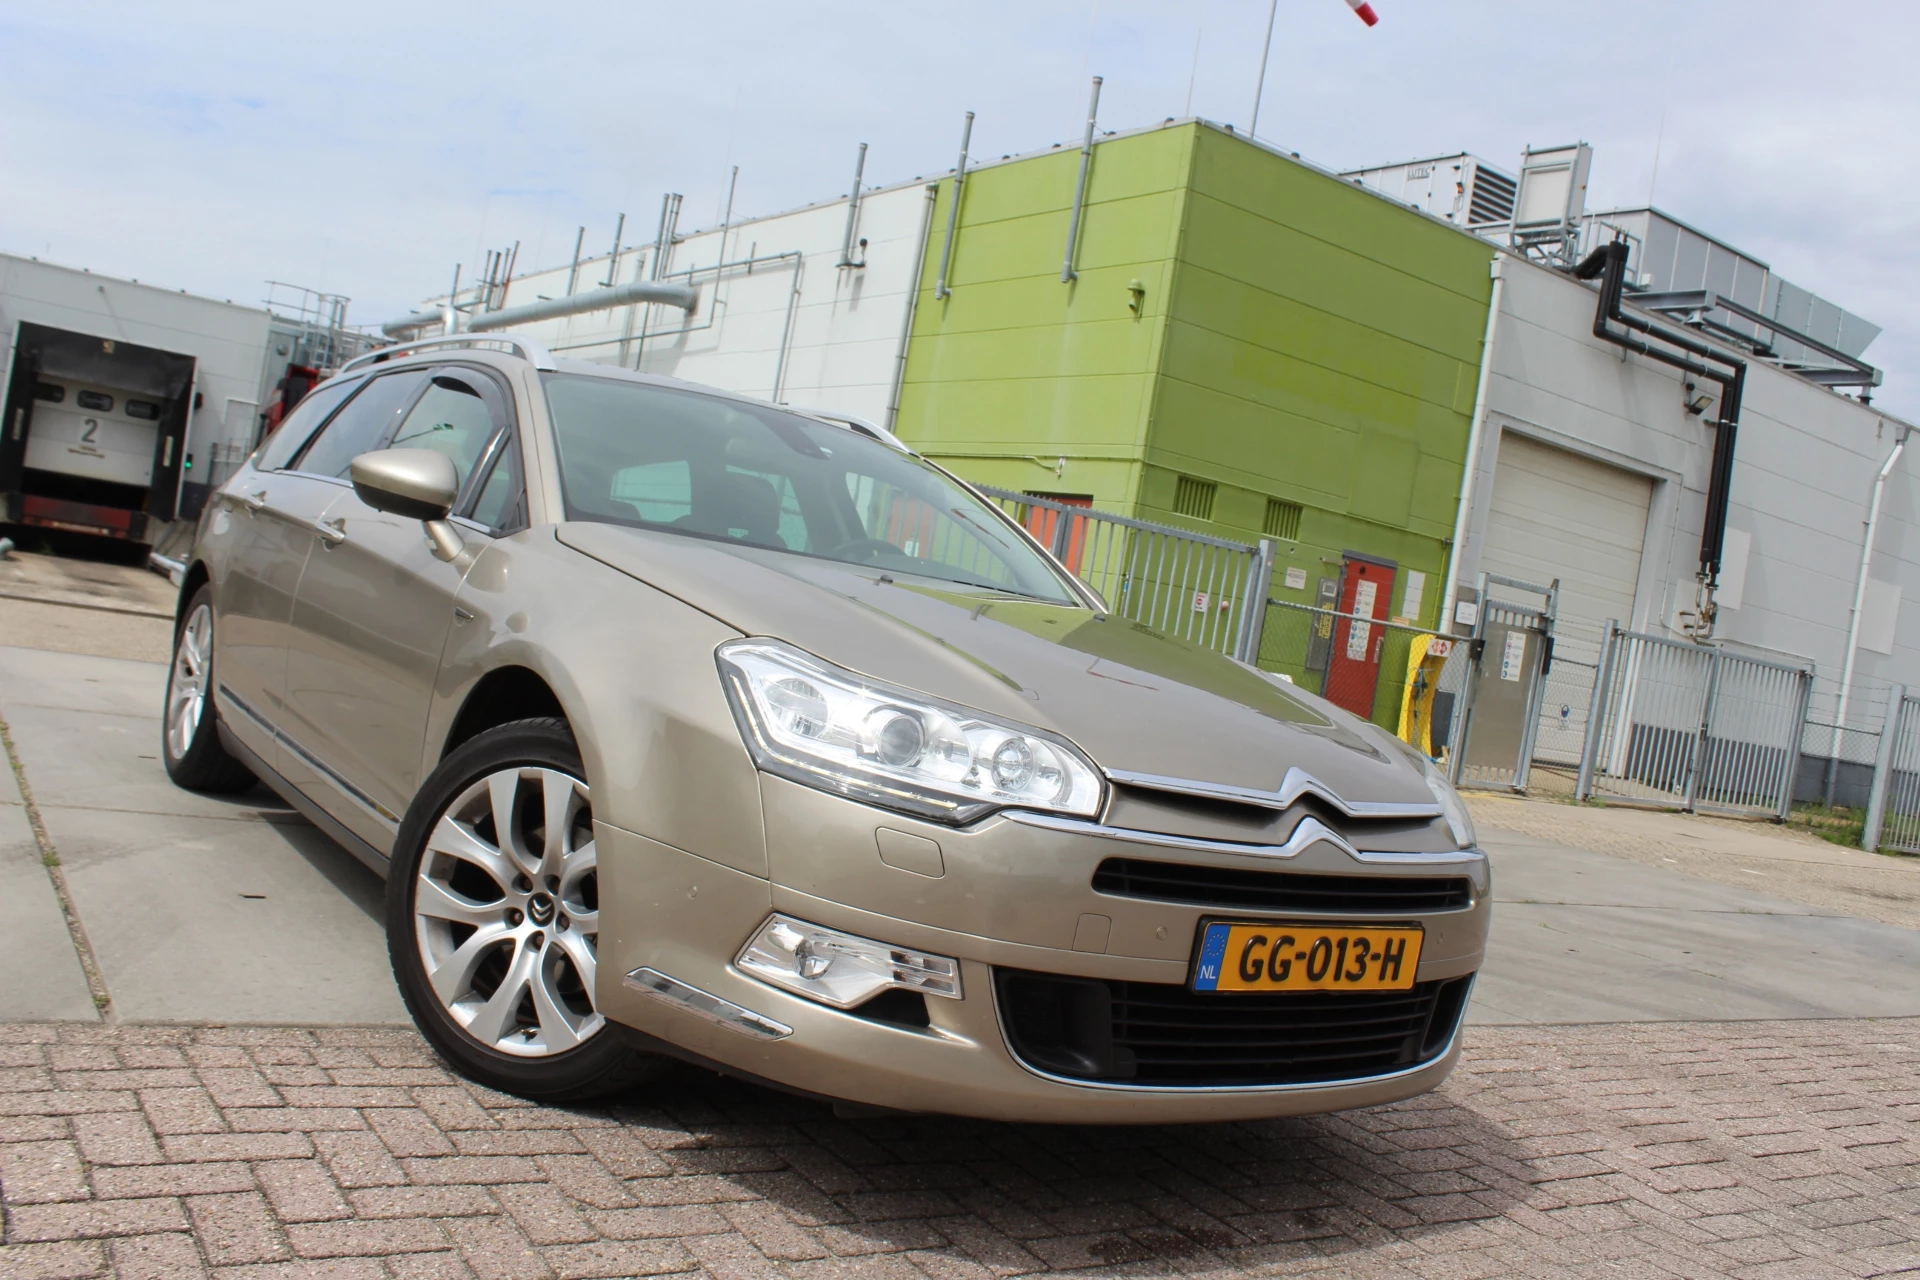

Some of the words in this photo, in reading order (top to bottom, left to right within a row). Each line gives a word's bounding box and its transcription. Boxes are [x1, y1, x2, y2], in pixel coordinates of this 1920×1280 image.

[81, 418, 98, 443] 2
[1239, 935, 1406, 982] GG-013-H
[1200, 964, 1216, 979] NL
